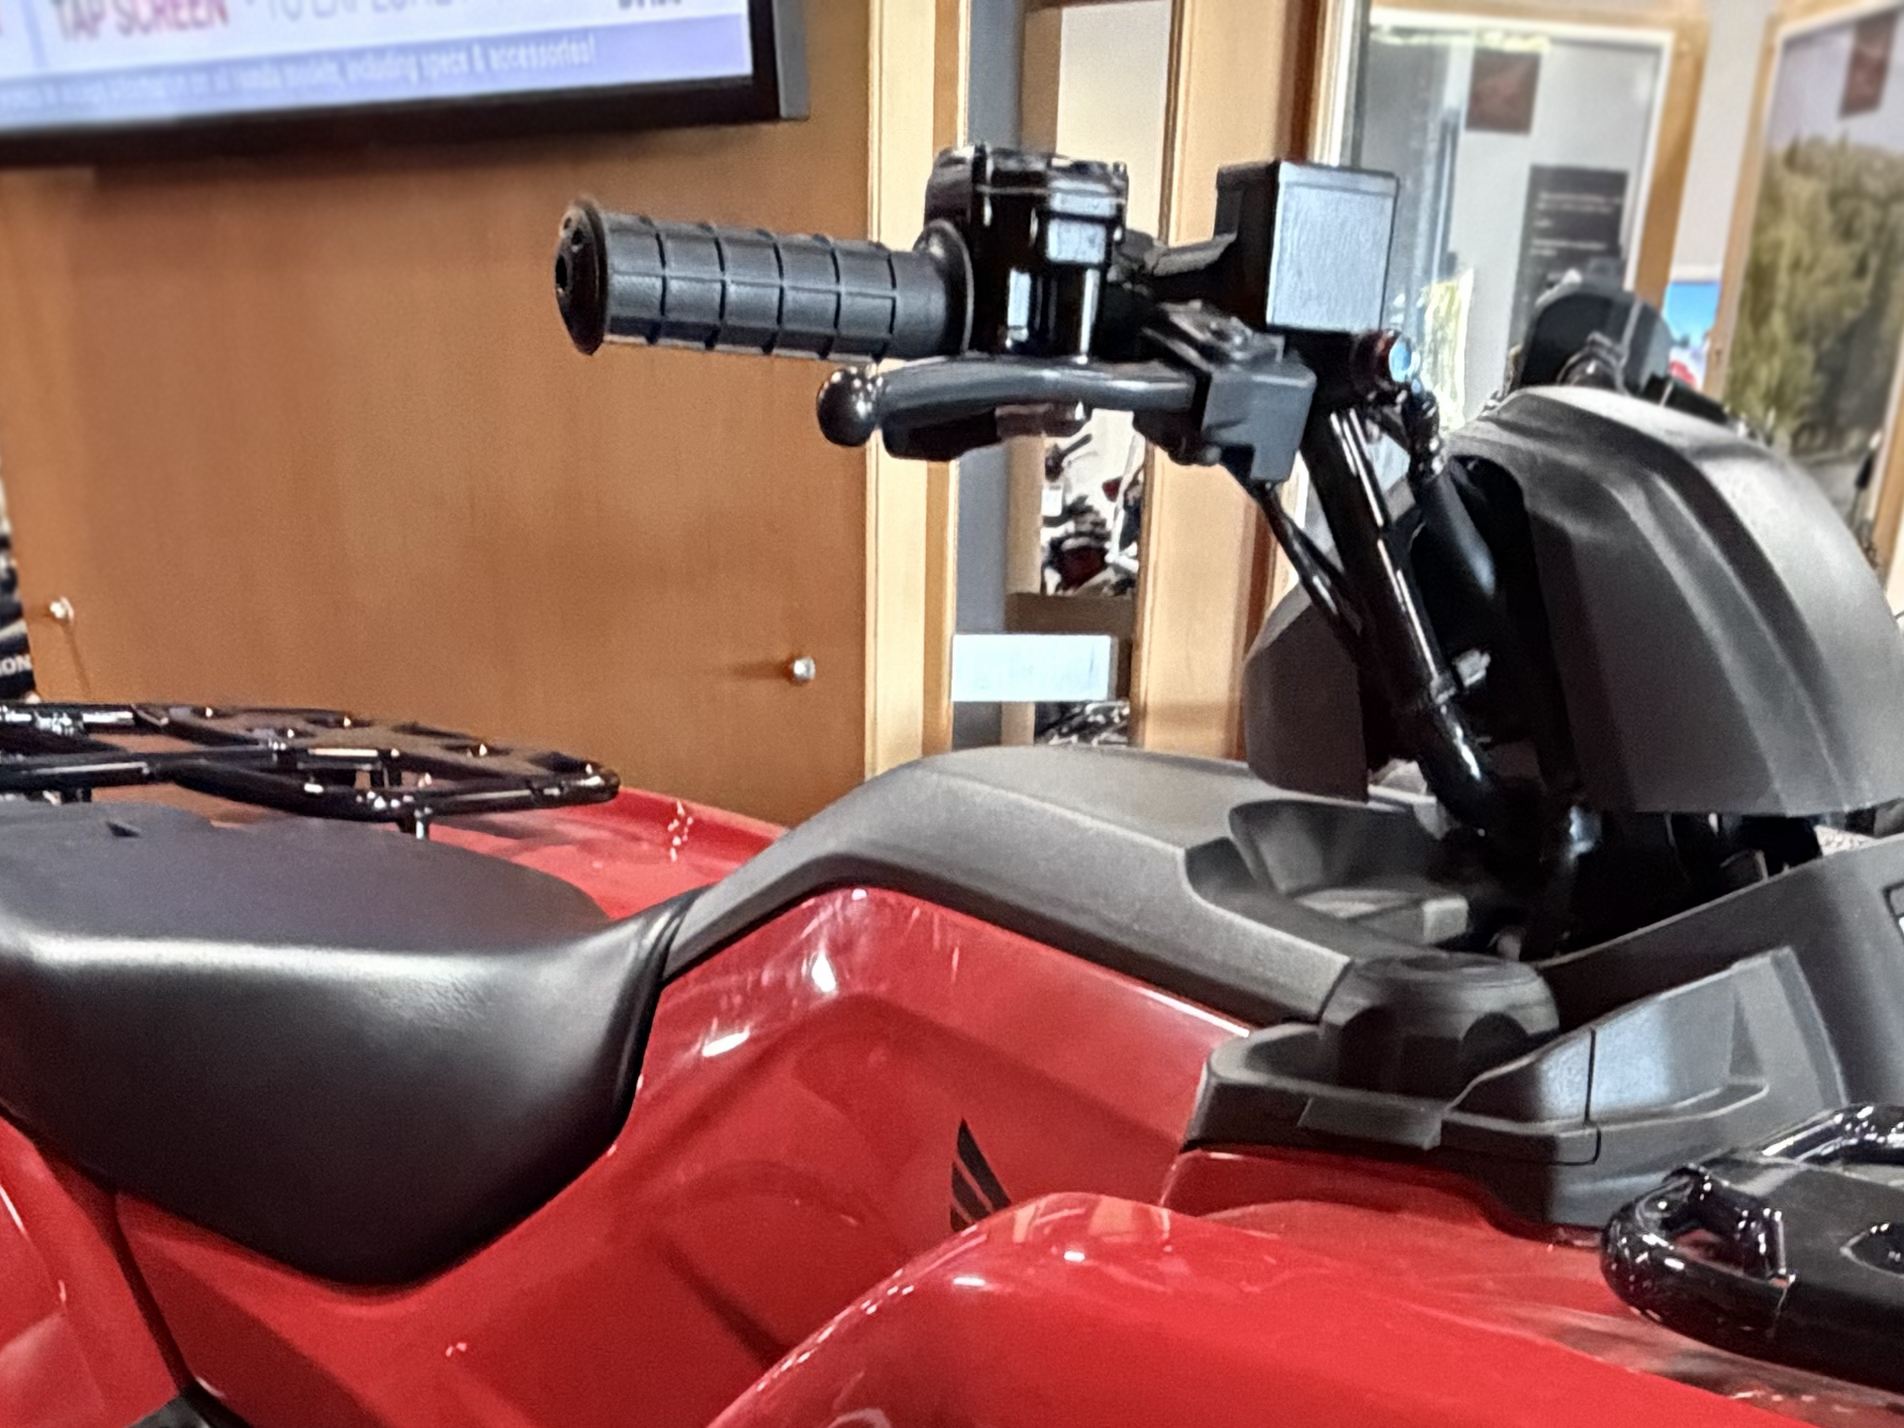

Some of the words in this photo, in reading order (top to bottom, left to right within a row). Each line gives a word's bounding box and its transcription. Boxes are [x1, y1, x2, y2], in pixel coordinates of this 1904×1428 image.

[345, 50, 418, 86] including
[421, 47, 467, 81] specs
[472, 42, 485, 73] &
[489, 35, 596, 72] accessories!
